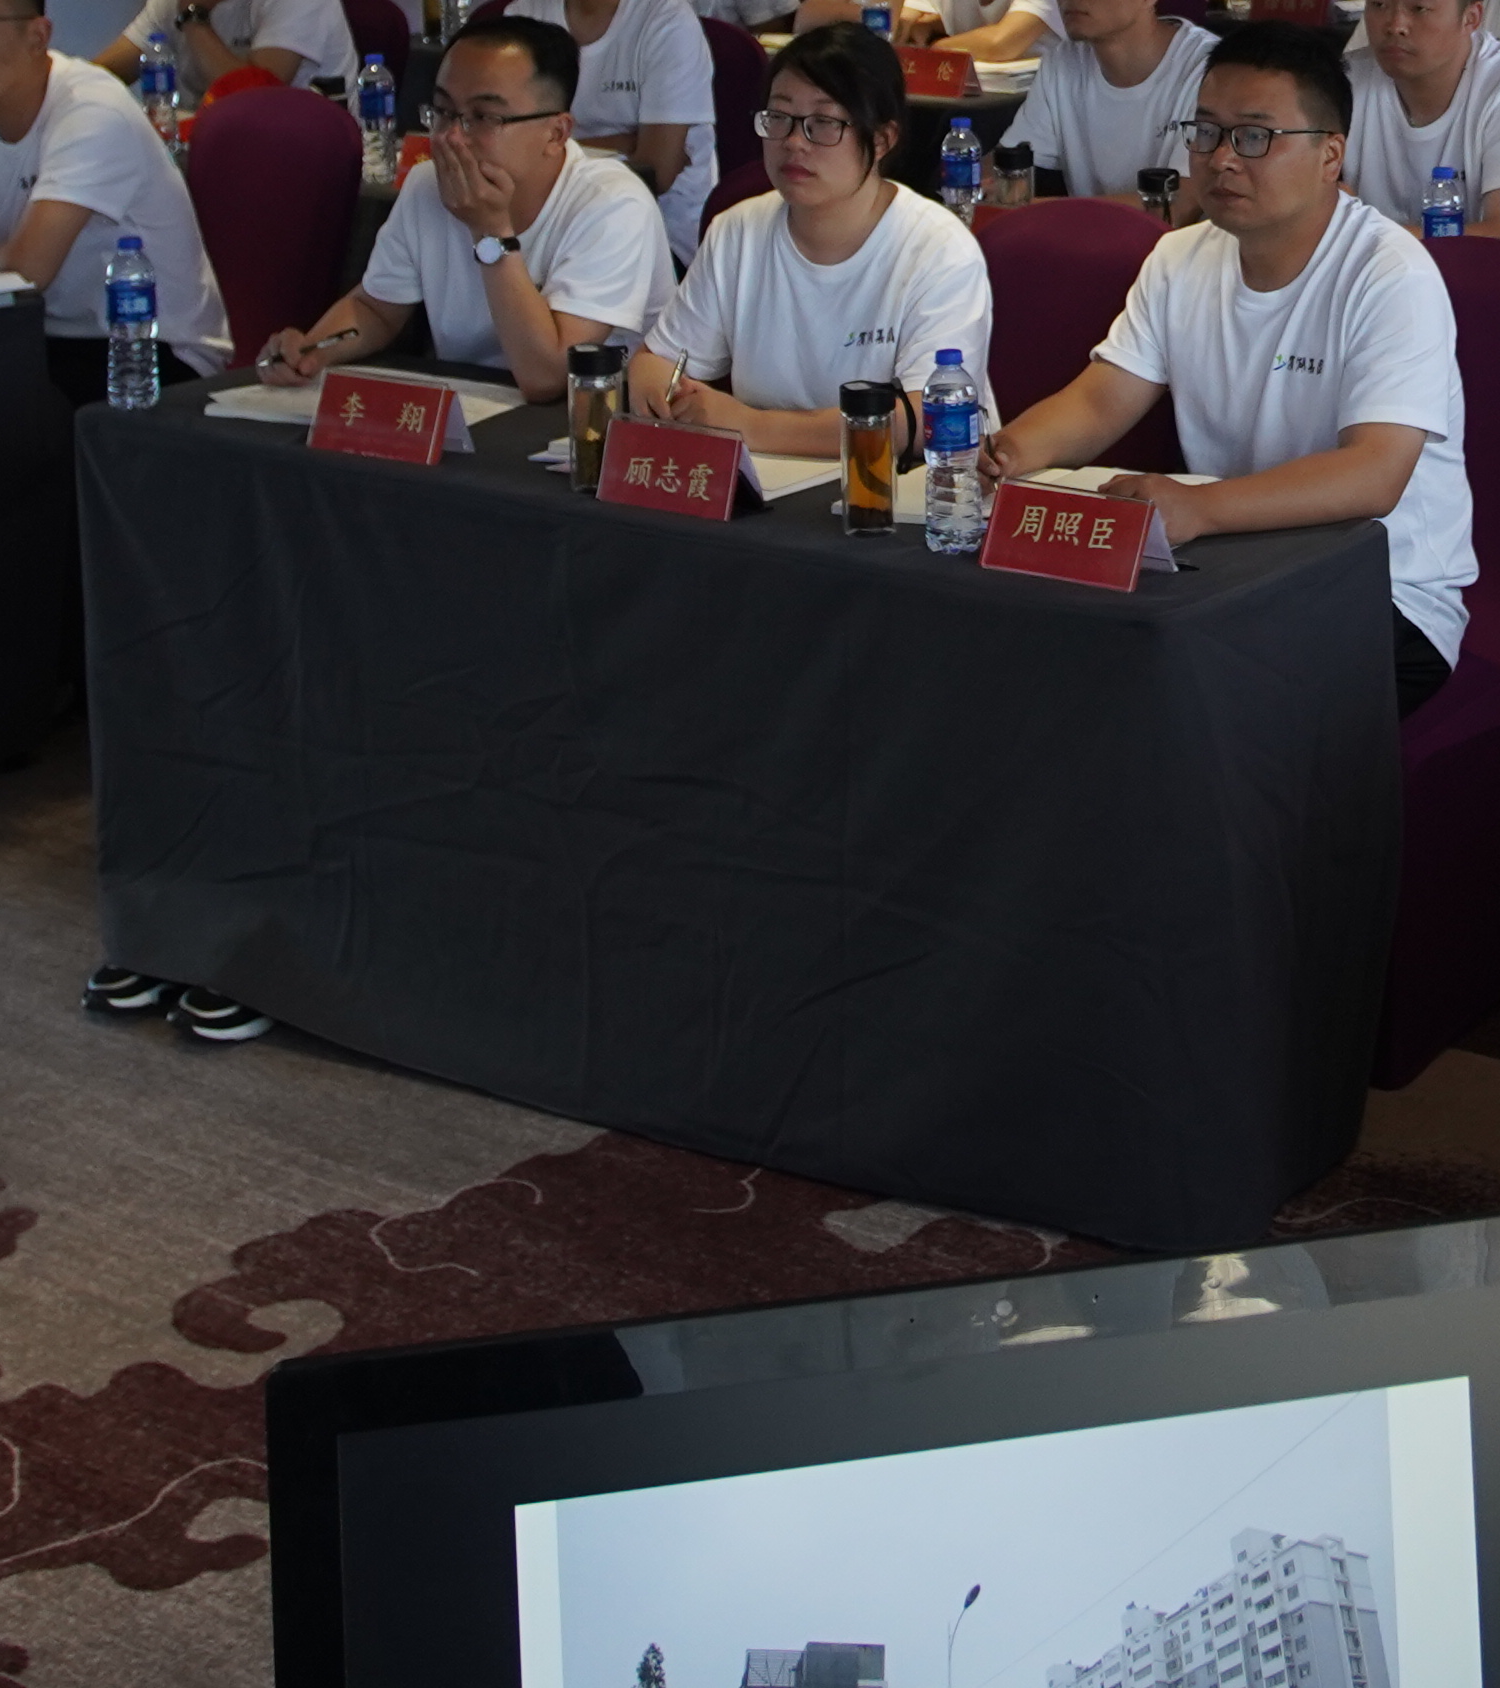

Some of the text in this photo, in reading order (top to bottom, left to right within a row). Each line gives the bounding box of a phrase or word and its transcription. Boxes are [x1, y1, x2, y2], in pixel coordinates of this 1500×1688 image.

[339, 391, 427, 433] 李翔
[622, 456, 714, 502] 顾志霞
[1011, 504, 1117, 550] 周照臣
